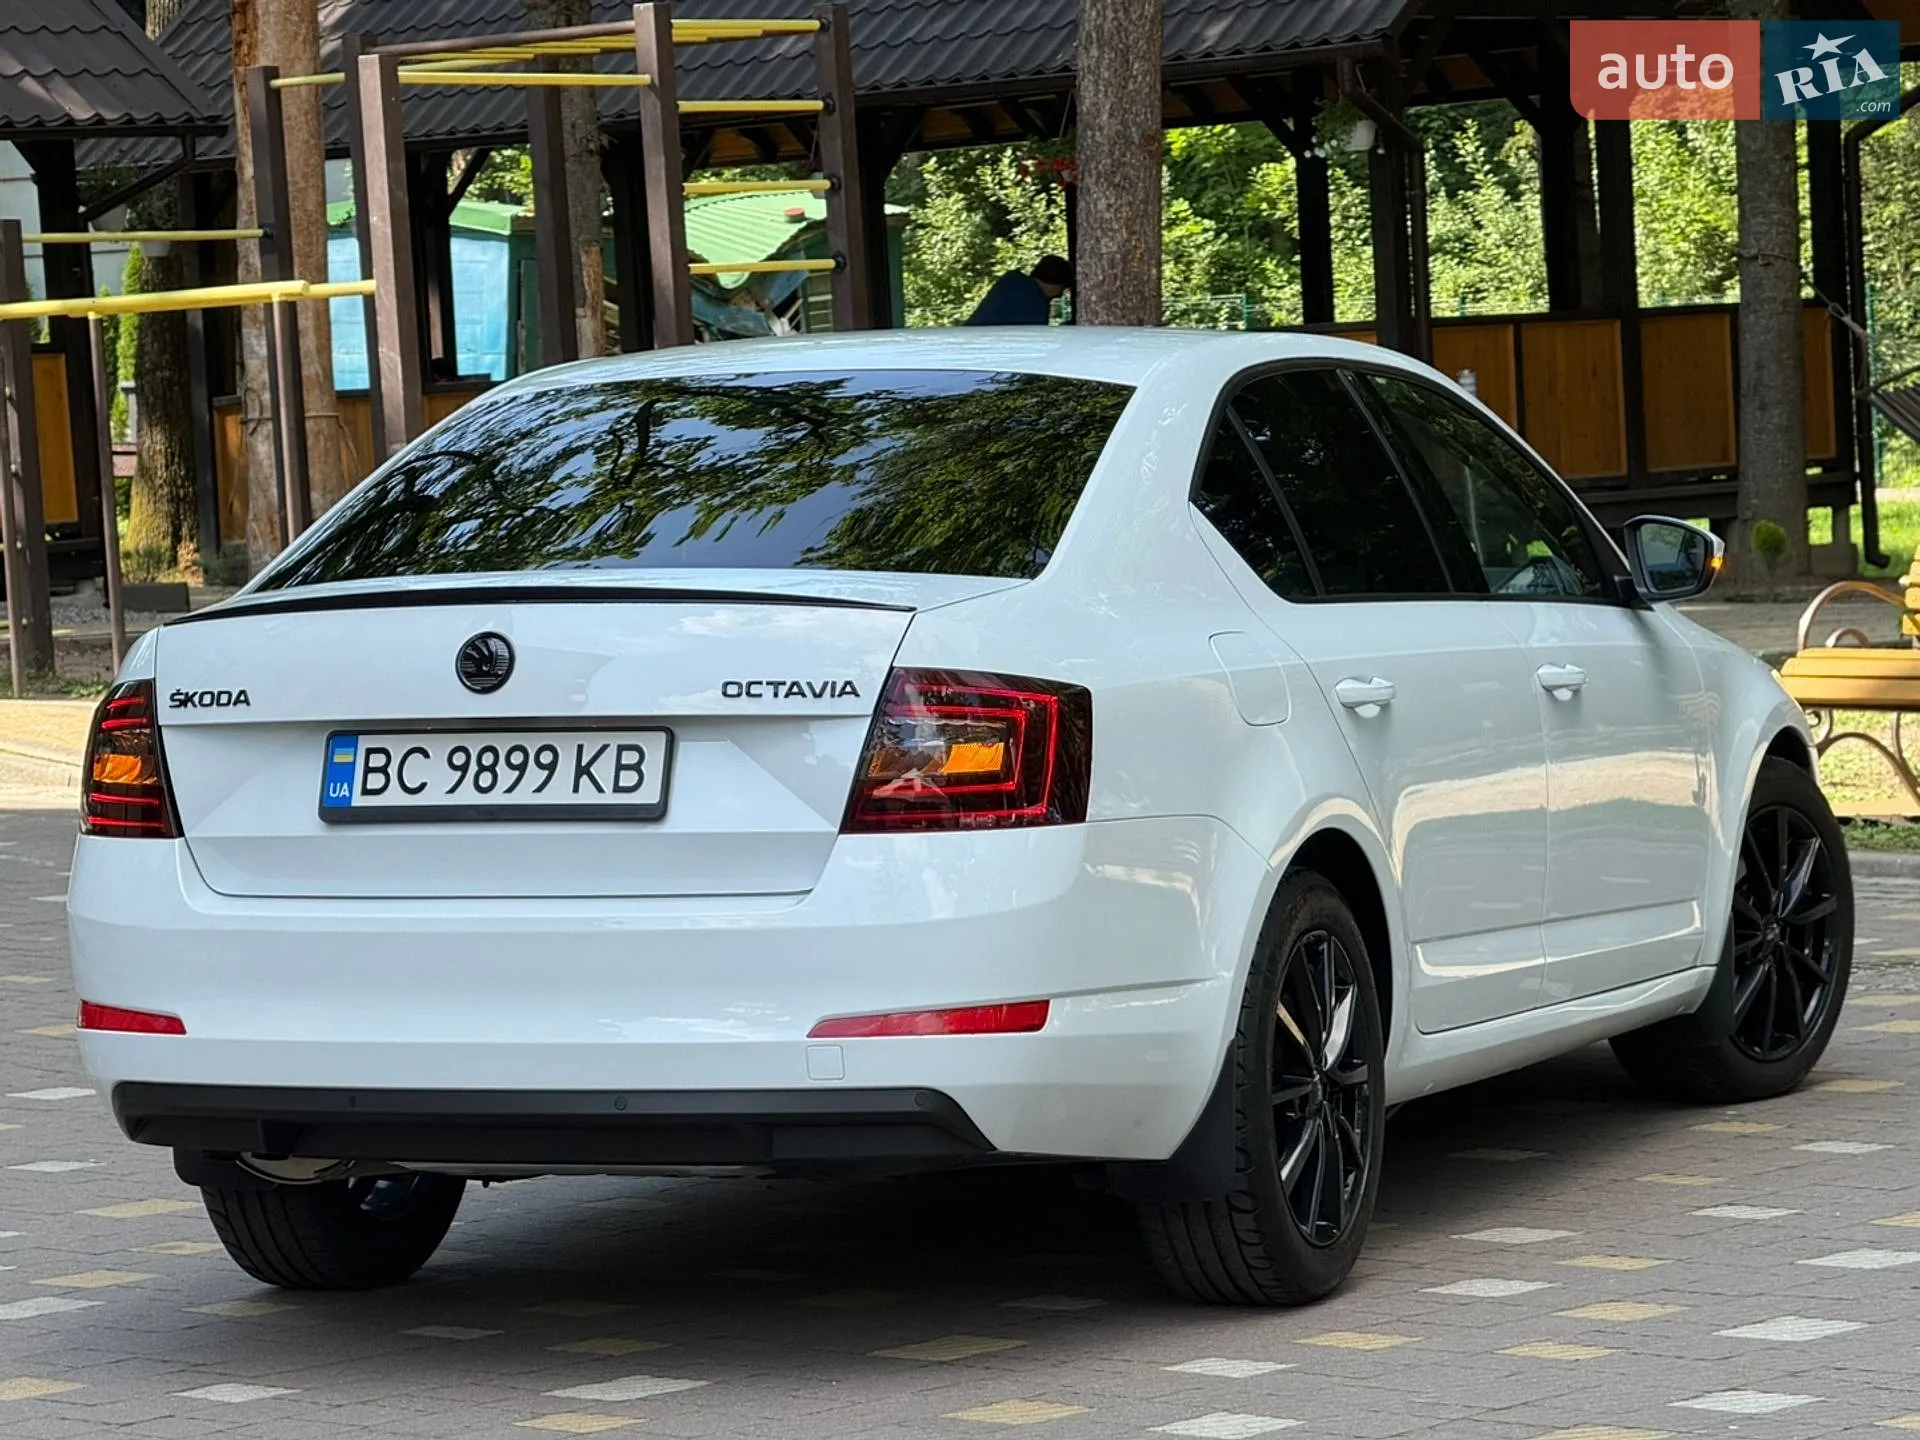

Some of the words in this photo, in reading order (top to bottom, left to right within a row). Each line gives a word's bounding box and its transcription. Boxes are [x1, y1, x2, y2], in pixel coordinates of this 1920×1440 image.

[169, 688, 251, 709] ŠKODA
[721, 680, 861, 699] OCTAVIA
[360, 746, 431, 796] BC
[445, 744, 560, 795] 9899
[572, 743, 646, 794] KB
[329, 782, 350, 798] UA
